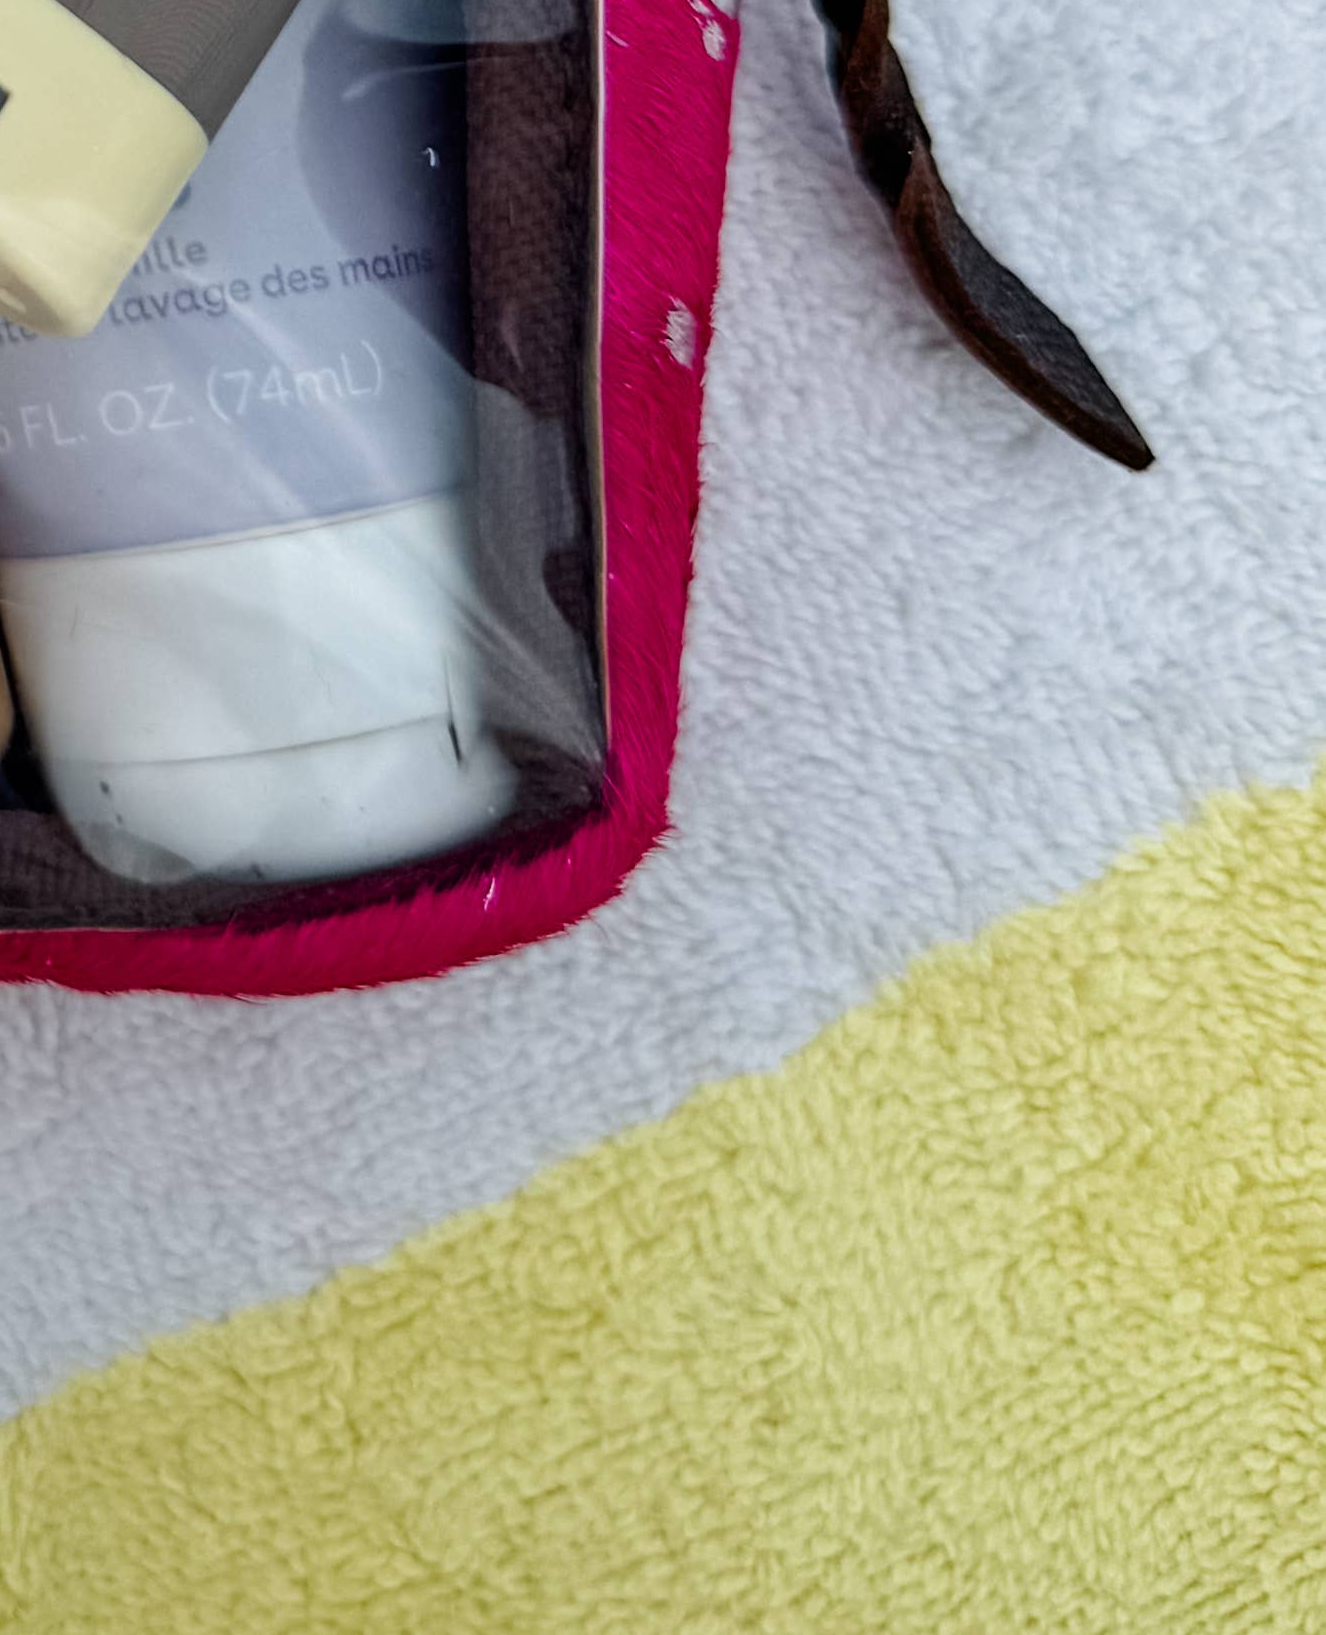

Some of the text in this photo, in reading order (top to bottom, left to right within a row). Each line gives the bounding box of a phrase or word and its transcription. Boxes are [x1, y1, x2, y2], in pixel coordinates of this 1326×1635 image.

[108, 277, 252, 327] lavage
[261, 261, 331, 300] des
[337, 244, 437, 288] mains
[131, 235, 211, 278] ille
[98, 381, 196, 437] OZ.
[206, 339, 385, 425] (74mL)
